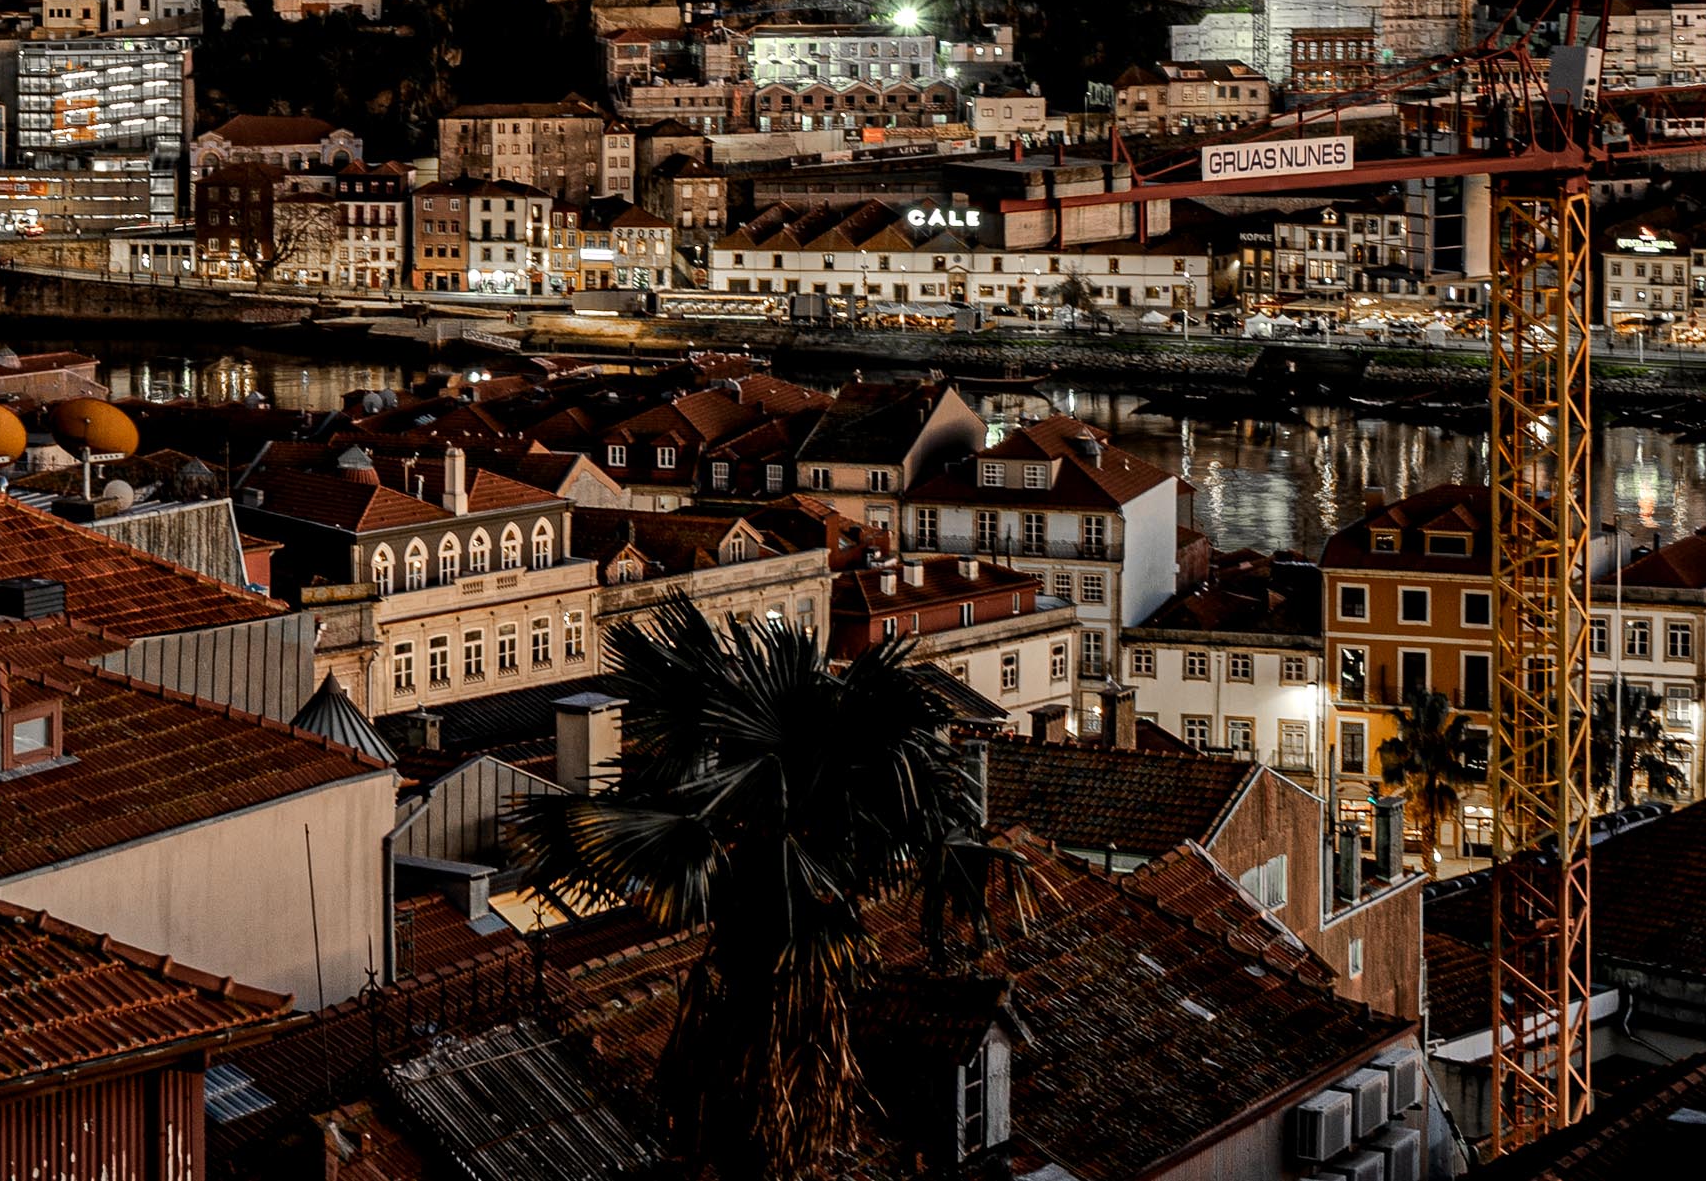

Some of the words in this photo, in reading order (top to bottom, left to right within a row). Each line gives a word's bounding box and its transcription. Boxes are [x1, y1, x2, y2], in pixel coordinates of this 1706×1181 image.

[1209, 148, 1277, 174] GRUAS
[1280, 142, 1346, 169] NUNES
[616, 228, 665, 240] SPORT
[1239, 232, 1273, 242] KOPKE
